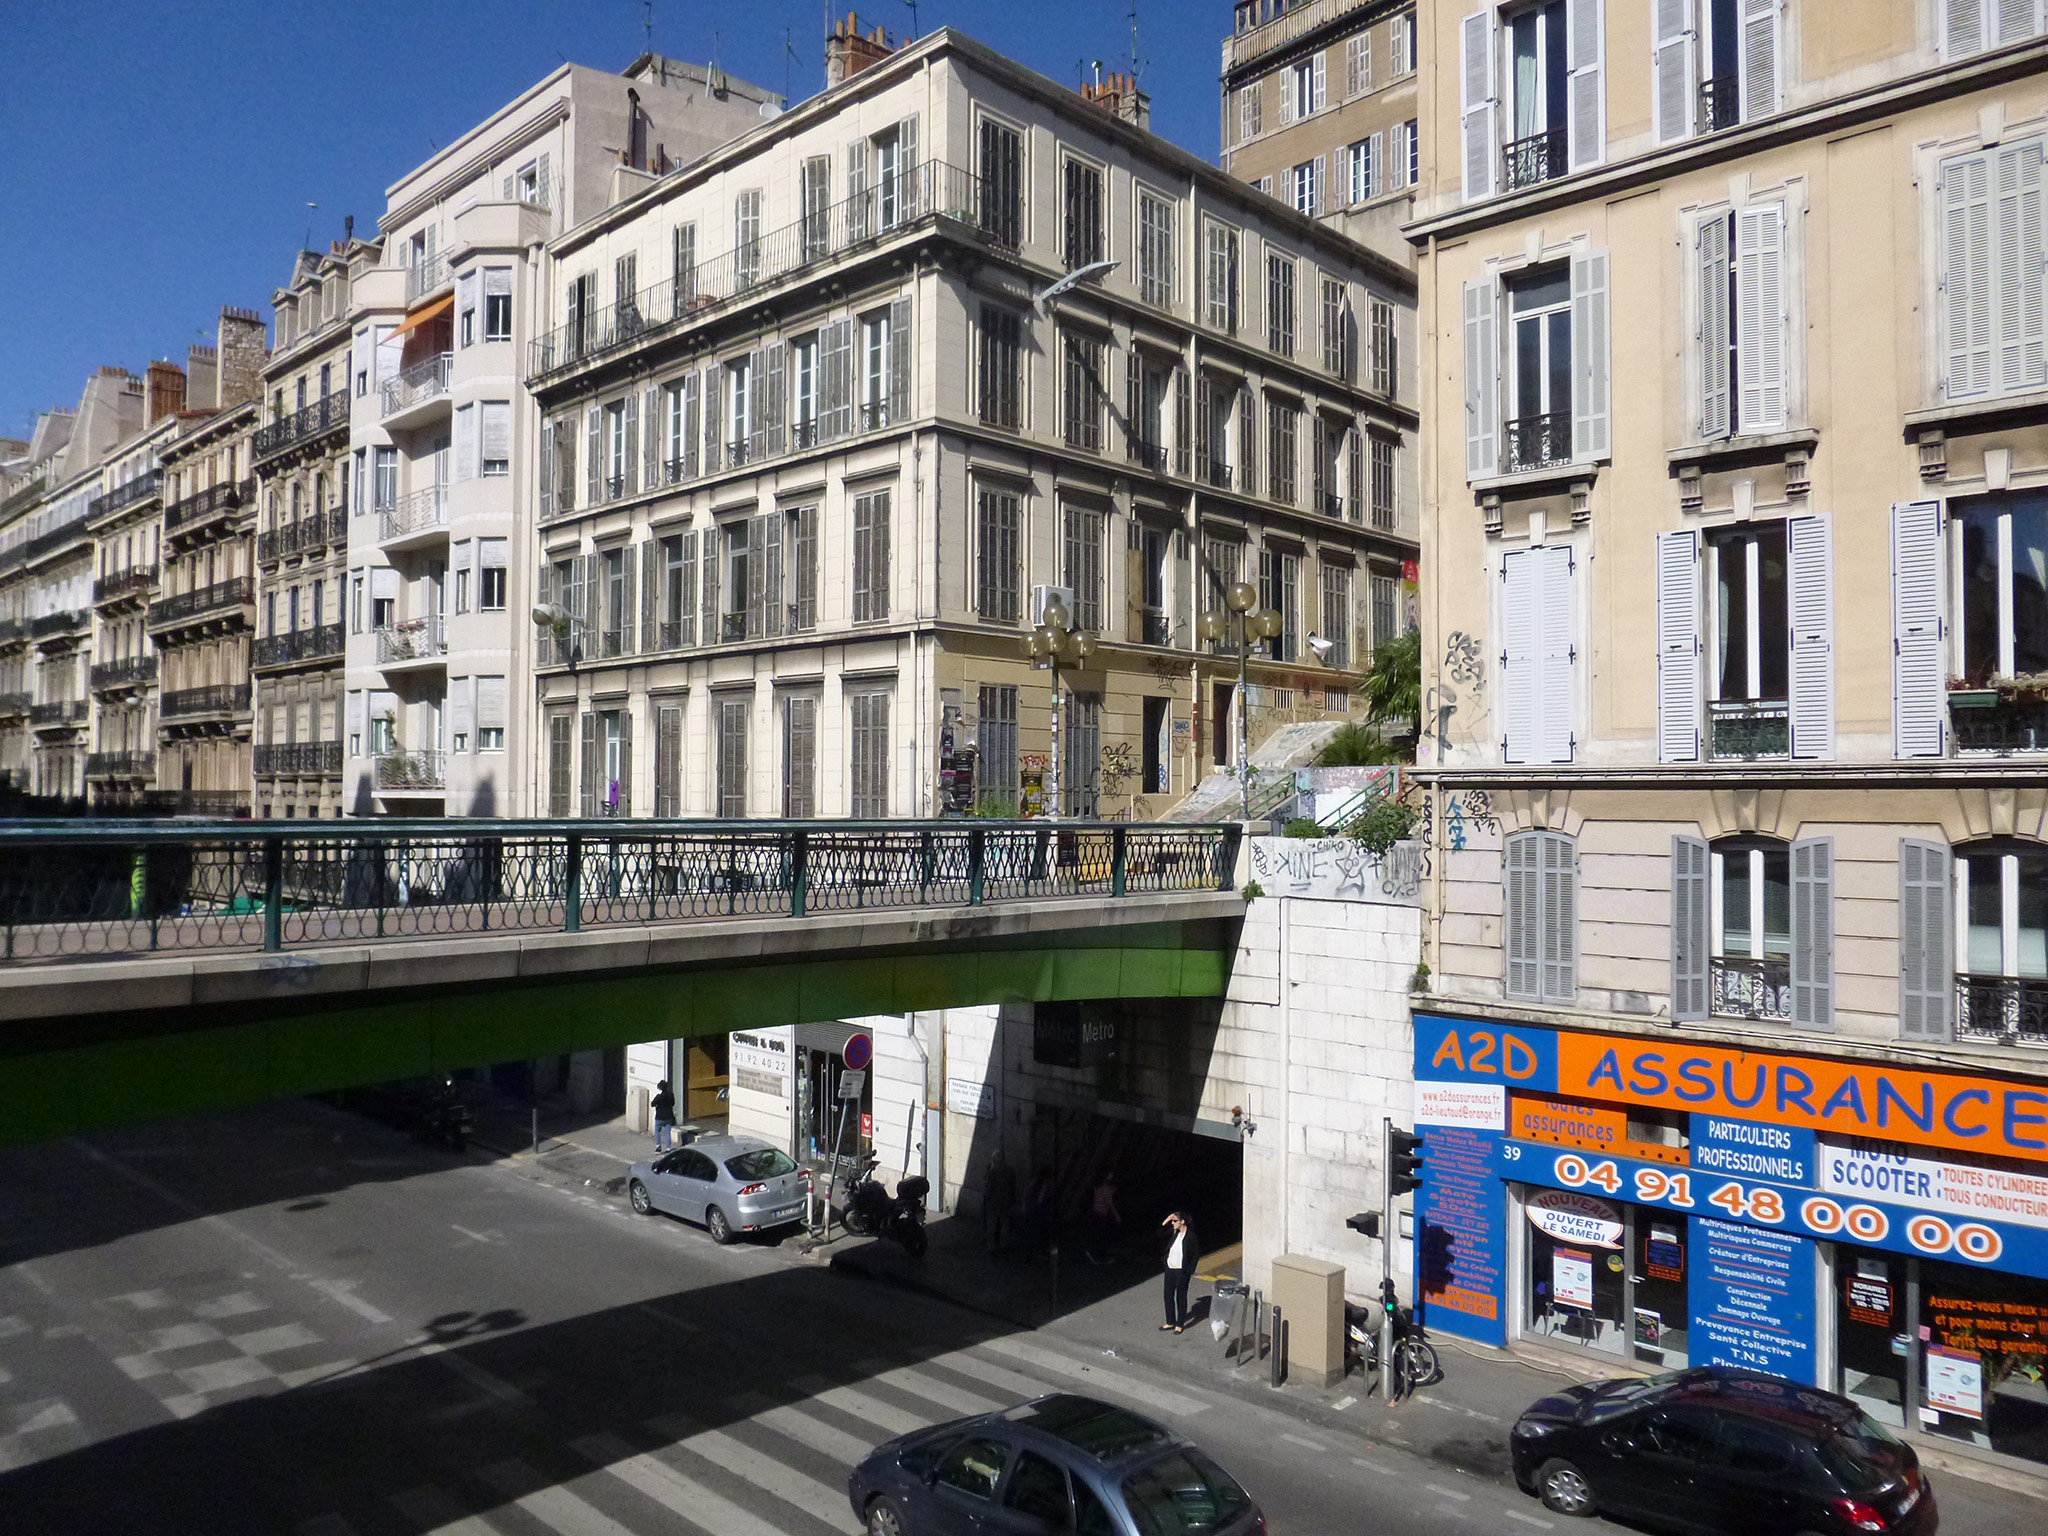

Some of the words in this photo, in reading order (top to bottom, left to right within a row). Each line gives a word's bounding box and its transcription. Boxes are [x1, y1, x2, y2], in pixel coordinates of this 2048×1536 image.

[1432, 1030, 1538, 1079] A2D
[1423, 1090, 1500, 1105] www.a2dassurances.fr
[1587, 1048, 2048, 1150] ASSURANCE
[1523, 1114, 1614, 1142] assurances
[1709, 1120, 1791, 1150] PARTICULIERS
[1503, 1145, 1521, 1161] 39
[1698, 1146, 1803, 1180] PROFESSIONNELS
[1833, 1159, 1931, 1199] SCOOTER
[1943, 1167, 1983, 1187] TOUTES
[1429, 1192, 1487, 1208] Scooter
[1440, 1188, 1476, 1200] Moto
[1943, 1187, 1971, 1206] TOUS
[1975, 1192, 2048, 1217] CONDUCTEUR
[1538, 1193, 1614, 1220] NOUVEAU
[1554, 1154, 1623, 1194] 04
[1634, 1168, 1695, 1208] 91
[1708, 1182, 1786, 1224] 48
[1800, 1197, 1890, 1243] 00
[1906, 1215, 2004, 1263] 00
[1543, 1221, 1557, 1232] LE
[1560, 1225, 1606, 1242] SAMEDI
[1546, 1212, 1604, 1231] OUVERT
[1699, 1218, 1742, 1233] Multirisques
[1708, 1230, 1751, 1244] Multirisques
[1751, 1238, 1792, 1252] Commerces
[1708, 1247, 1740, 1259] Créateur
[1741, 1253, 1790, 1269] d'Entreprises
[1714, 1265, 1765, 1282] Responsabilité
[1765, 1276, 1787, 1287] Civile
[1726, 1286, 1772, 1302] Construction
[1730, 1296, 1768, 1311] Décennale
[1717, 1304, 1750, 1319] Dommage
[1750, 1311, 1781, 1326] Ouvrage
[1929, 1295, 2003, 1313] Assurez-vous
[2003, 1303, 2038, 1316] mieux
[1935, 1314, 1947, 1326] et
[1948, 1315, 1974, 1330] pour
[1975, 1317, 2008, 1332] moins
[2010, 1318, 2037, 1334] cher
[1708, 1332, 1739, 1345] Santé
[1741, 1339, 1792, 1357] Collective
[1752, 1330, 1807, 1350] Entreprise
[1941, 1331, 1976, 1349] Tarifs
[1977, 1335, 1998, 1350] bas
